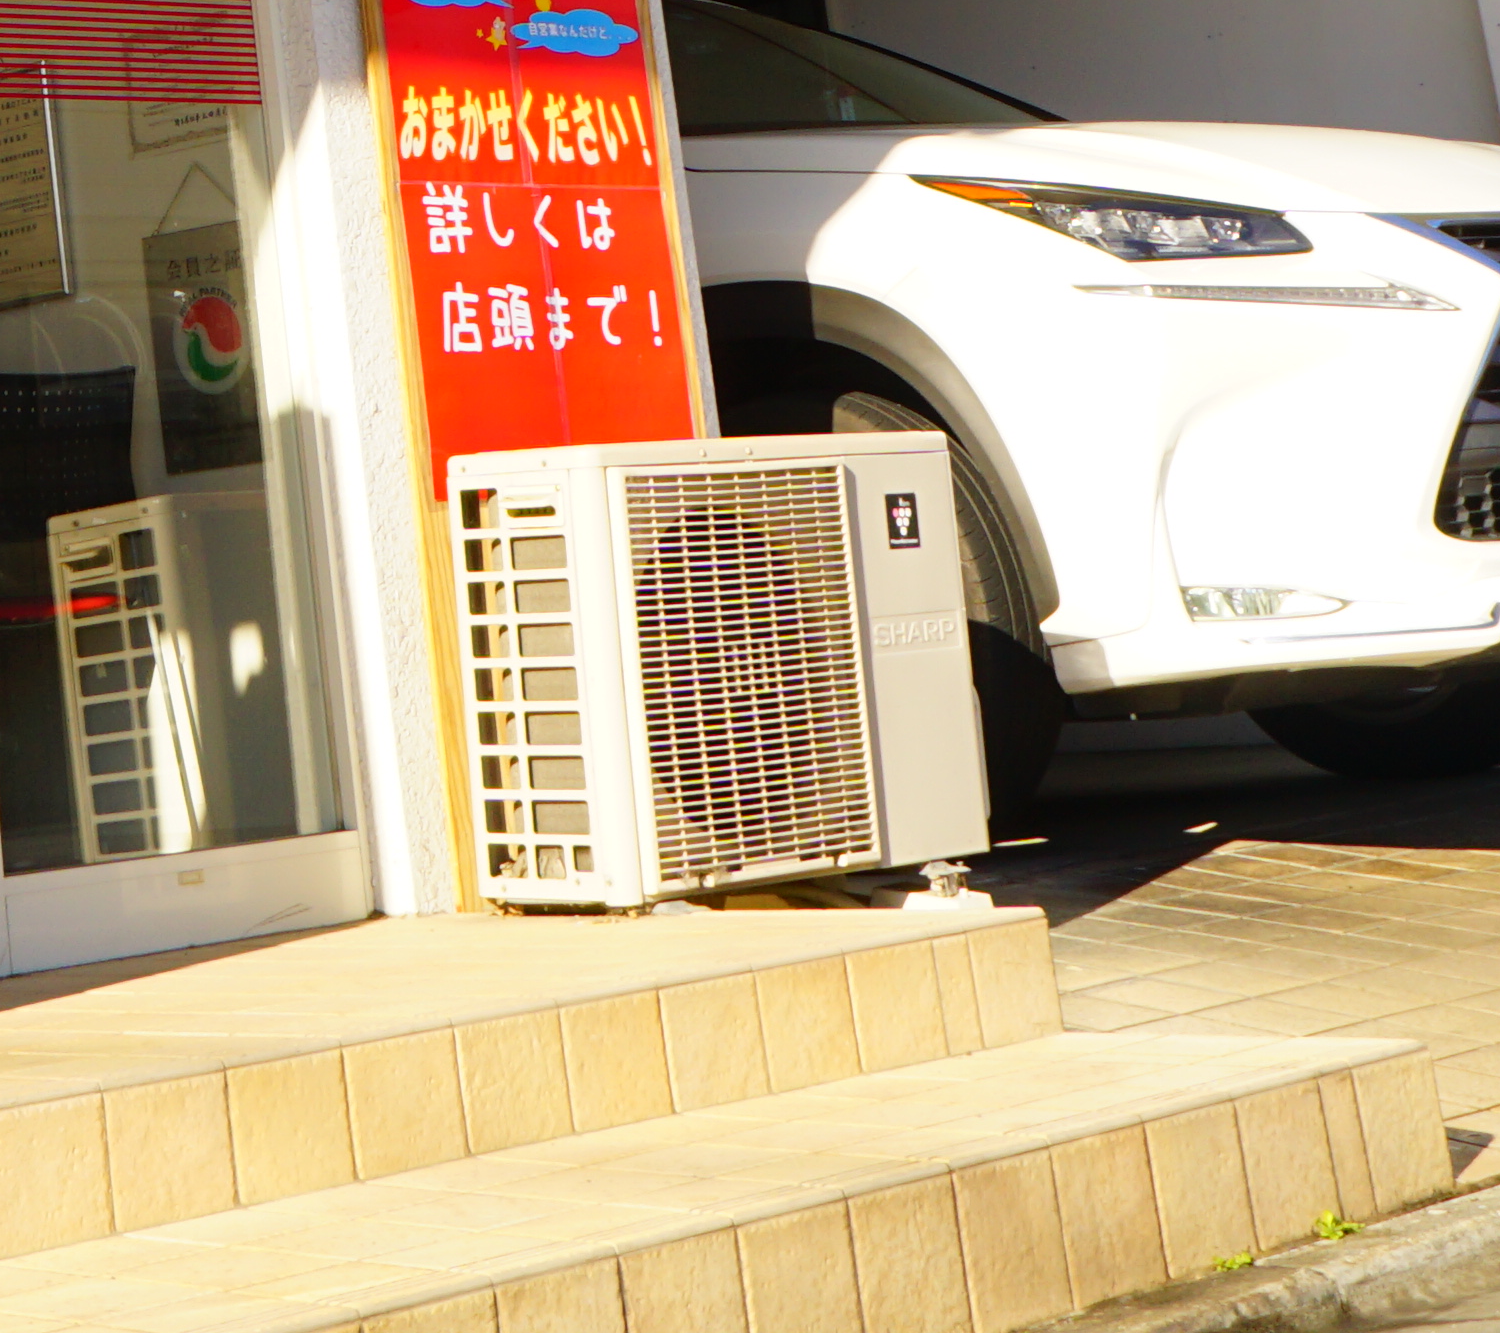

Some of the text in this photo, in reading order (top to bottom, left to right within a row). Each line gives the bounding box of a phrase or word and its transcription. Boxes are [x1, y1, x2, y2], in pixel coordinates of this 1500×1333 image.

[400, 85, 653, 167] おまかせください！
[422, 181, 615, 254] 詳しくは
[442, 282, 663, 353] 店頭まで！
[873, 618, 955, 647] SHARP
